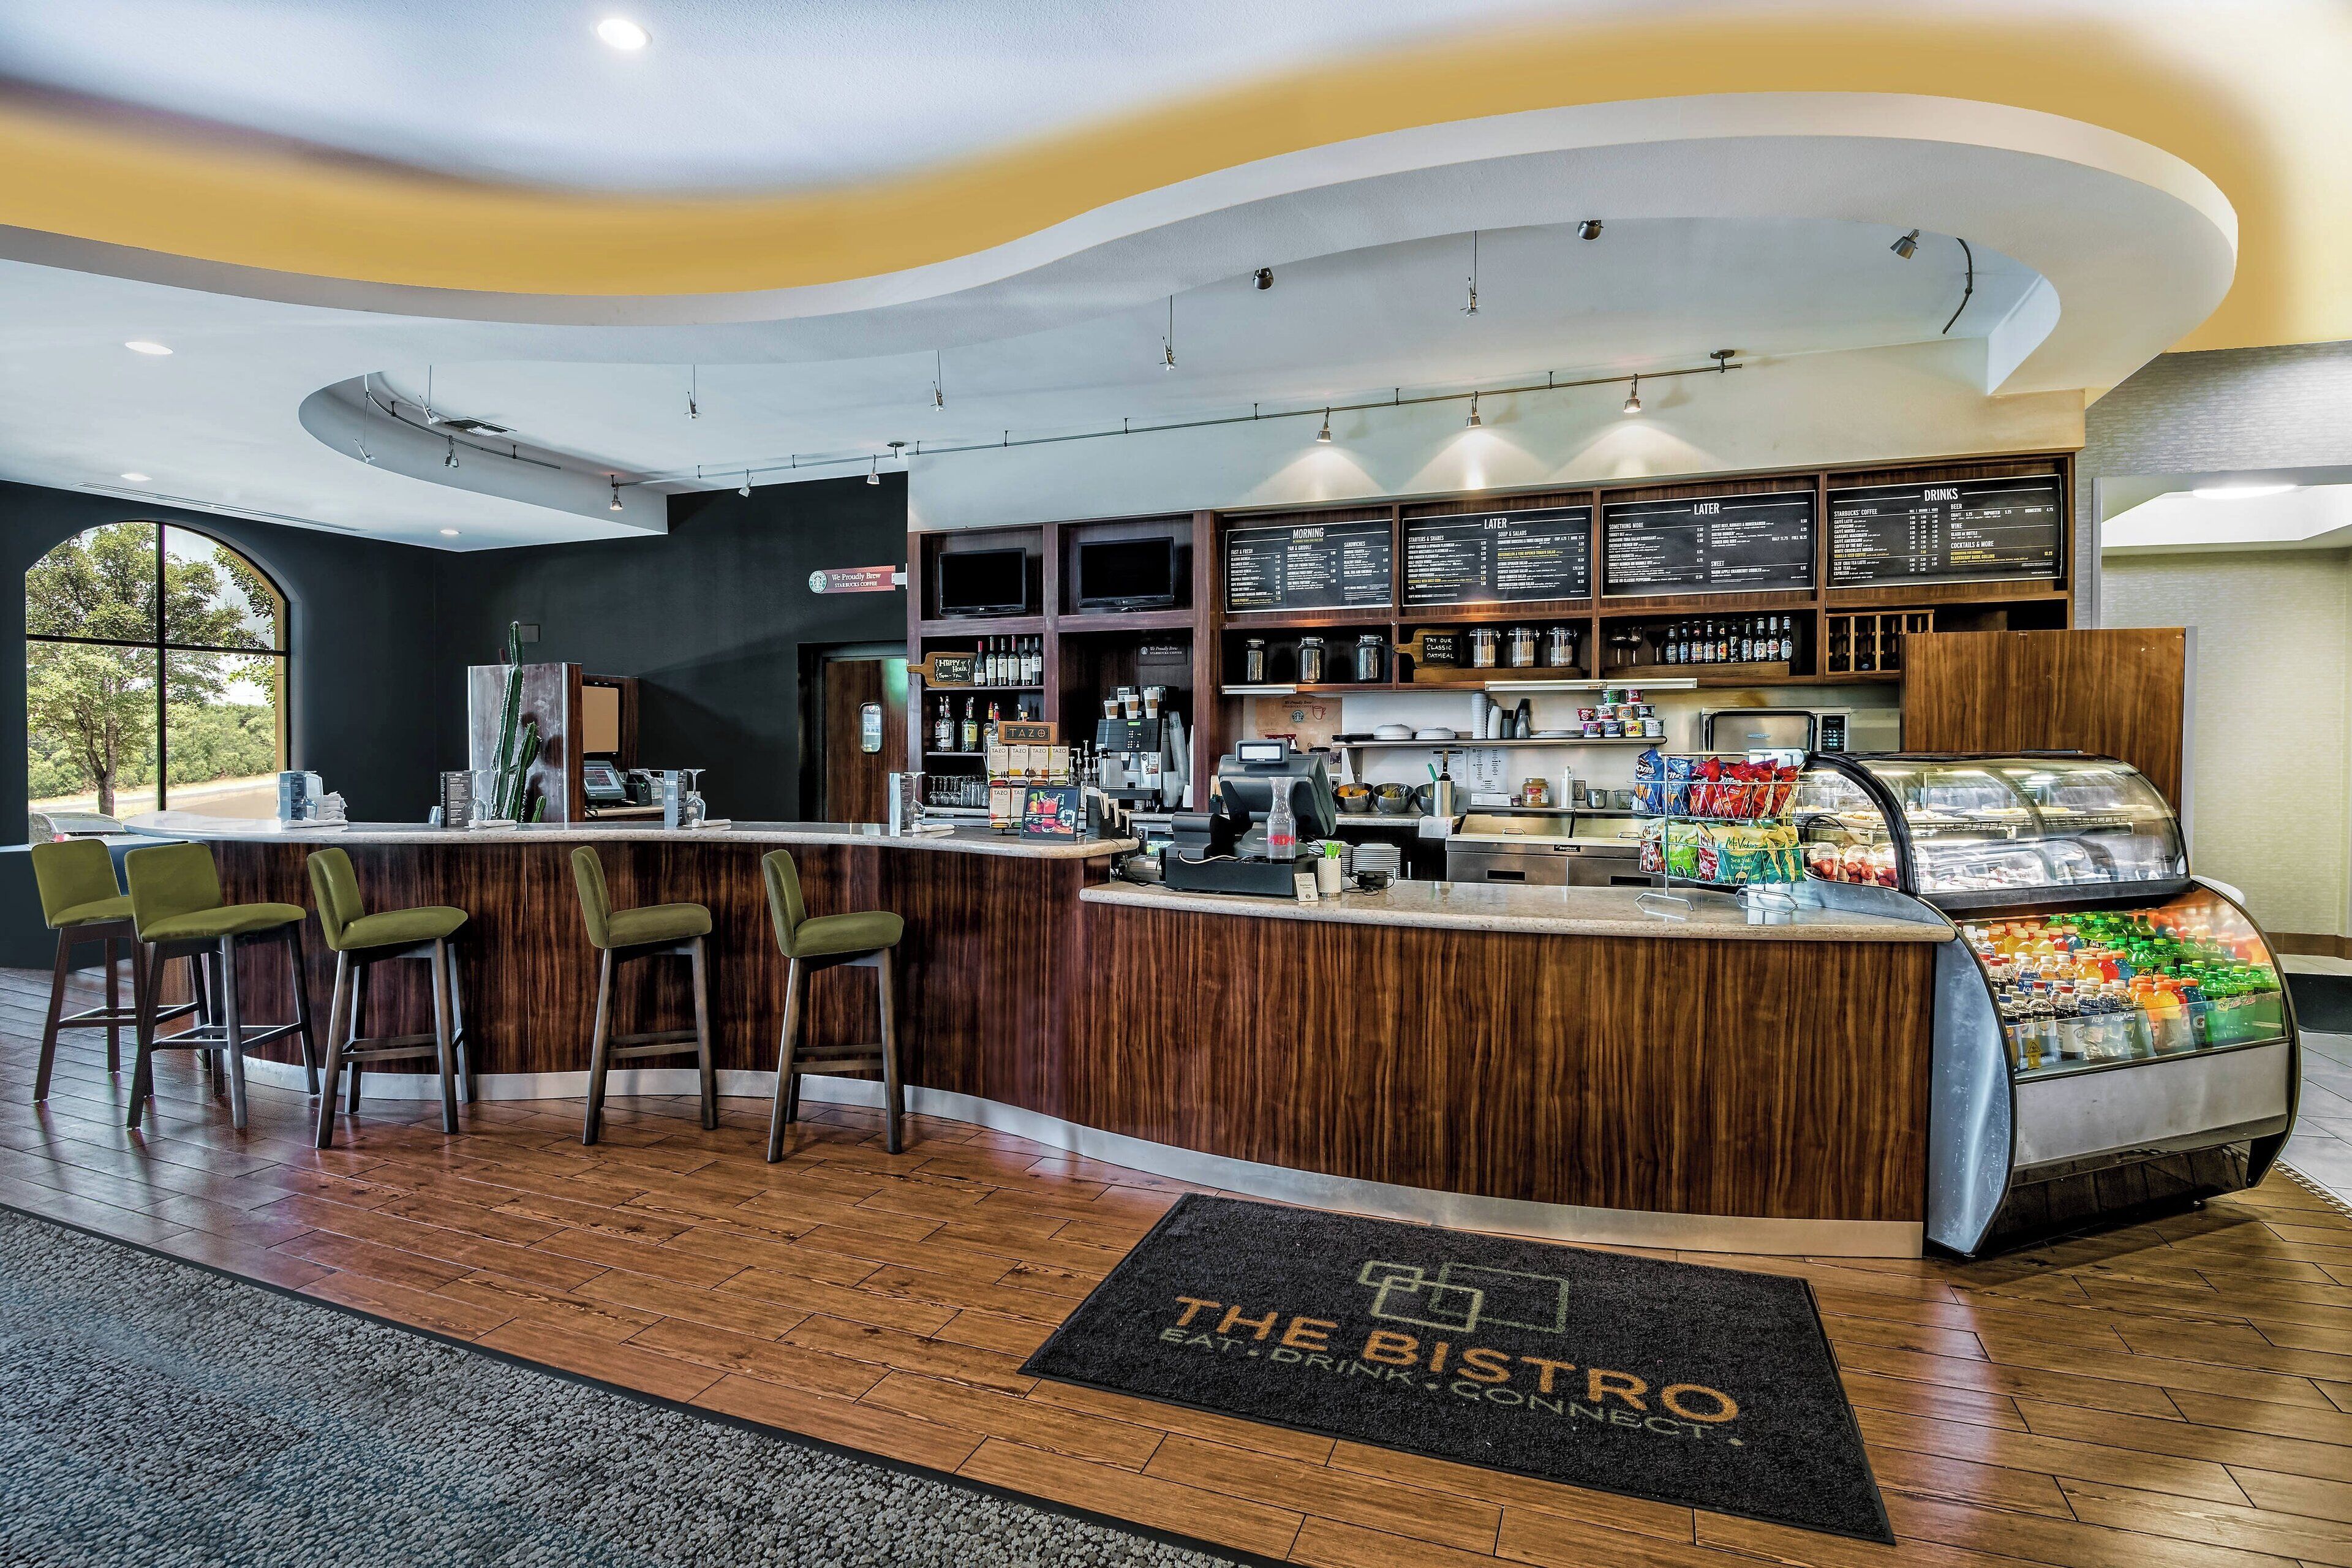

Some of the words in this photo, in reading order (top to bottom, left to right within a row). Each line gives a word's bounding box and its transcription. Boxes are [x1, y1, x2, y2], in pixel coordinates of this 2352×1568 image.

[1924, 488, 1958, 501] DRINKS
[1694, 503, 1720, 515] LATER
[1484, 518, 1507, 529] LATER
[1293, 527, 1324, 539] MORNING
[1009, 728, 1046, 738] TAZO
[1176, 1296, 1338, 1351] THE
[1362, 1330, 1739, 1423] BISTRO
